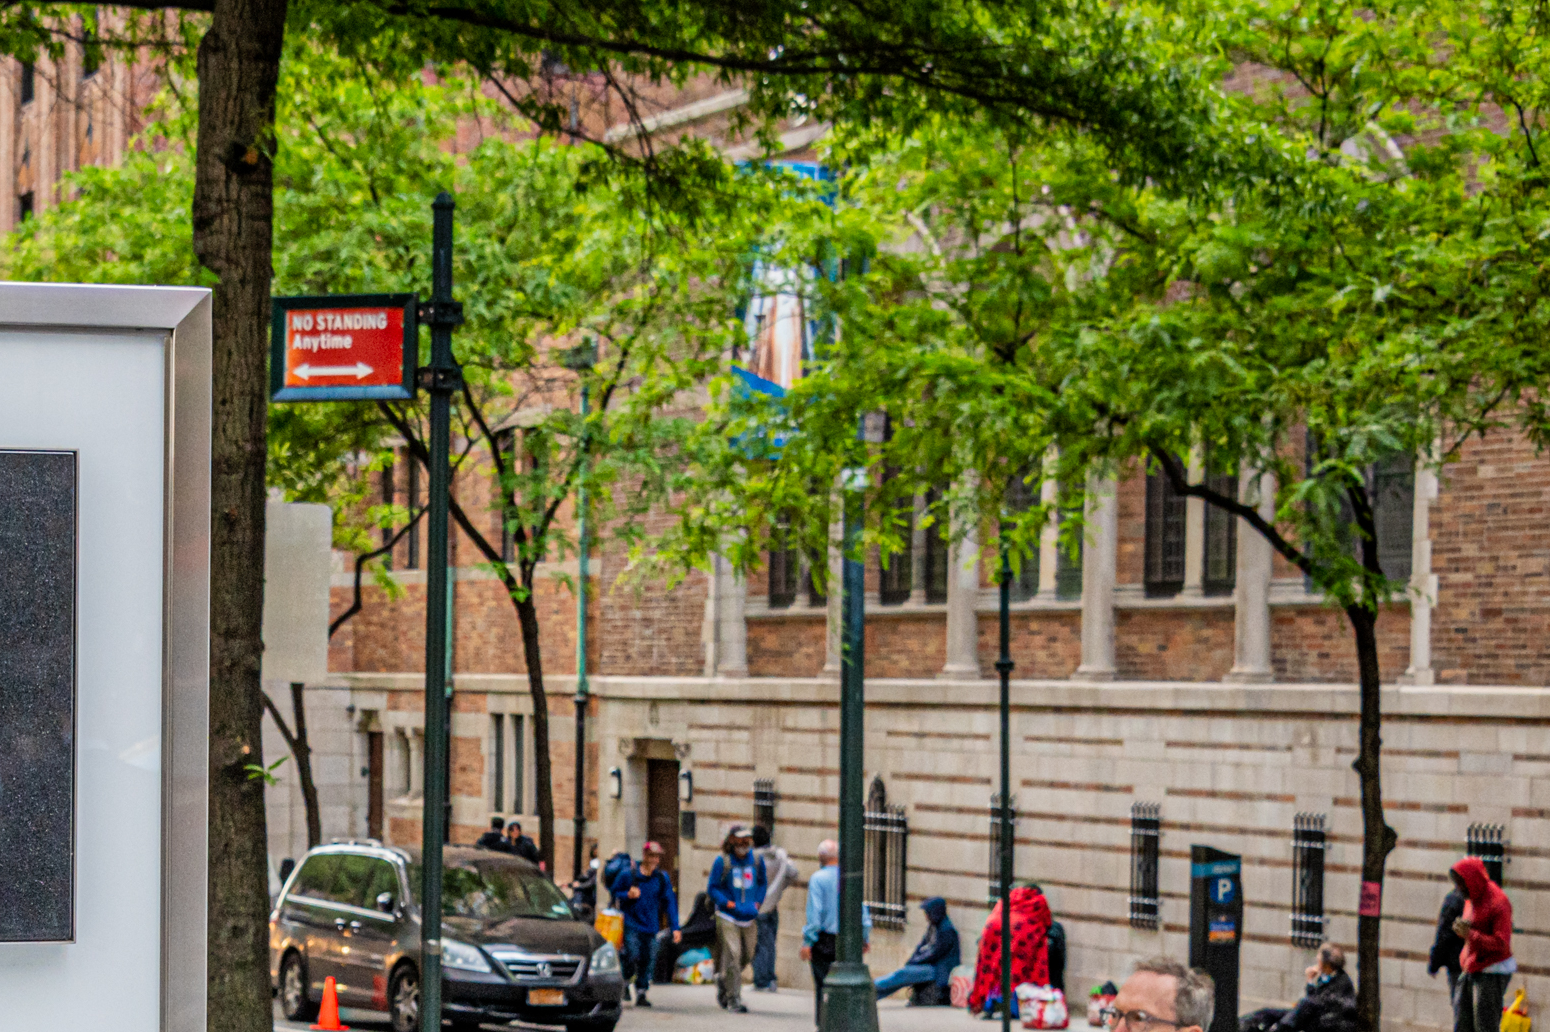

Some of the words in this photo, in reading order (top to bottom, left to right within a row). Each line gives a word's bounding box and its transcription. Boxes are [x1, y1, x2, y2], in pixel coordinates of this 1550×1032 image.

[292, 314, 313, 331] NO
[316, 312, 388, 331] STANDING
[293, 334, 352, 353] Anytime
[1217, 878, 1233, 902] P
